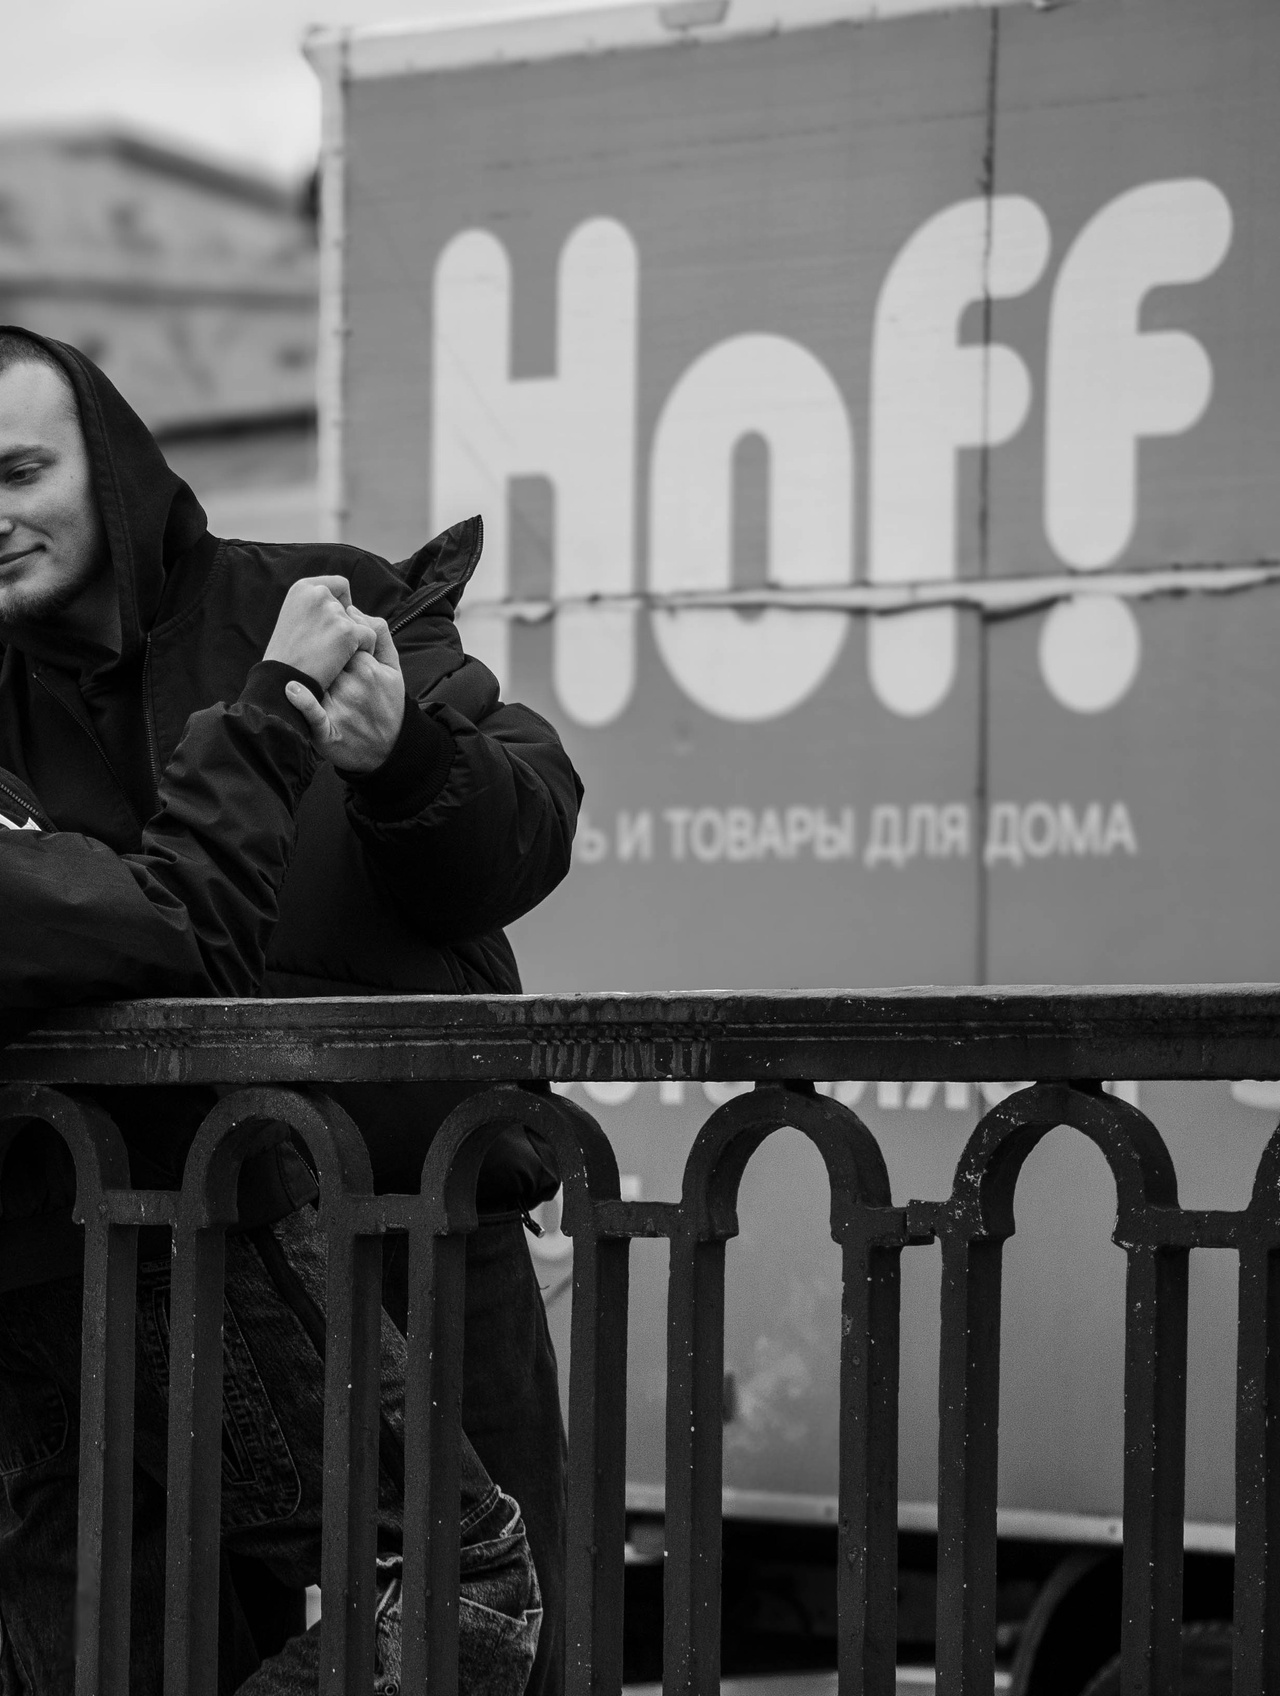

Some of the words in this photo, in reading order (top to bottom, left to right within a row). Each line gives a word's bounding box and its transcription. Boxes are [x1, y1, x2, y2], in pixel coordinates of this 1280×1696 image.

[617, 809, 653, 861] И
[663, 805, 856, 862] ТОВАРЫ
[862, 801, 971, 870] ДЛЯ
[983, 800, 1139, 869] ДОМА
